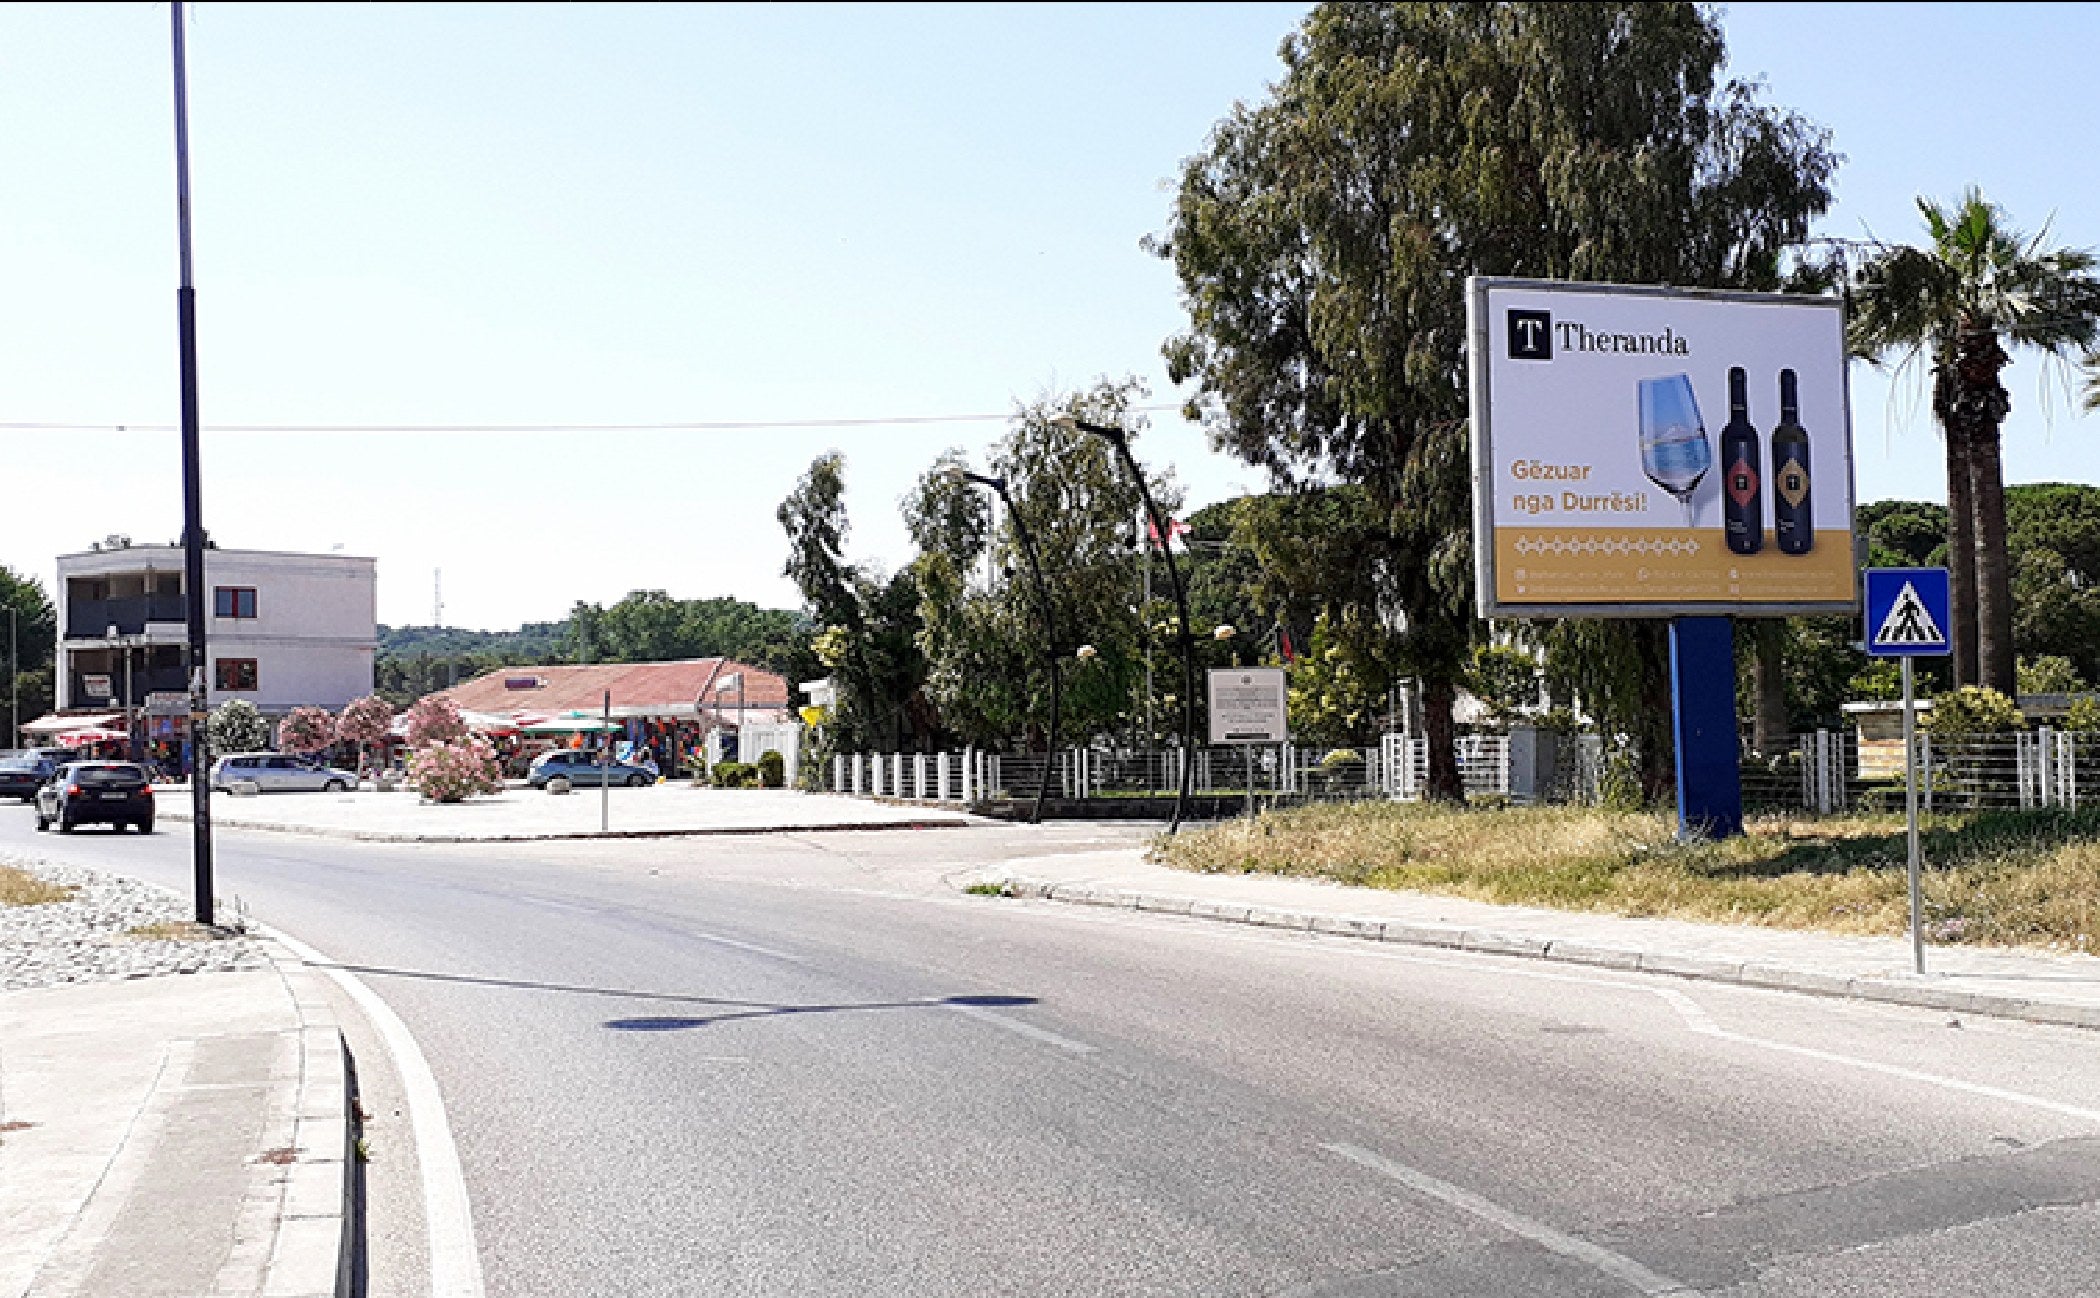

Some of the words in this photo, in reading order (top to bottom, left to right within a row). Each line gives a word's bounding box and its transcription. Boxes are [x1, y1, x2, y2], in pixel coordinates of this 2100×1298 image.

[1517, 318, 1543, 351] T
[1555, 320, 1690, 356] Theranda
[1511, 459, 1592, 479] Gëzuar
[1513, 494, 1554, 514] nga
[1563, 490, 1647, 511] Durrësi!
